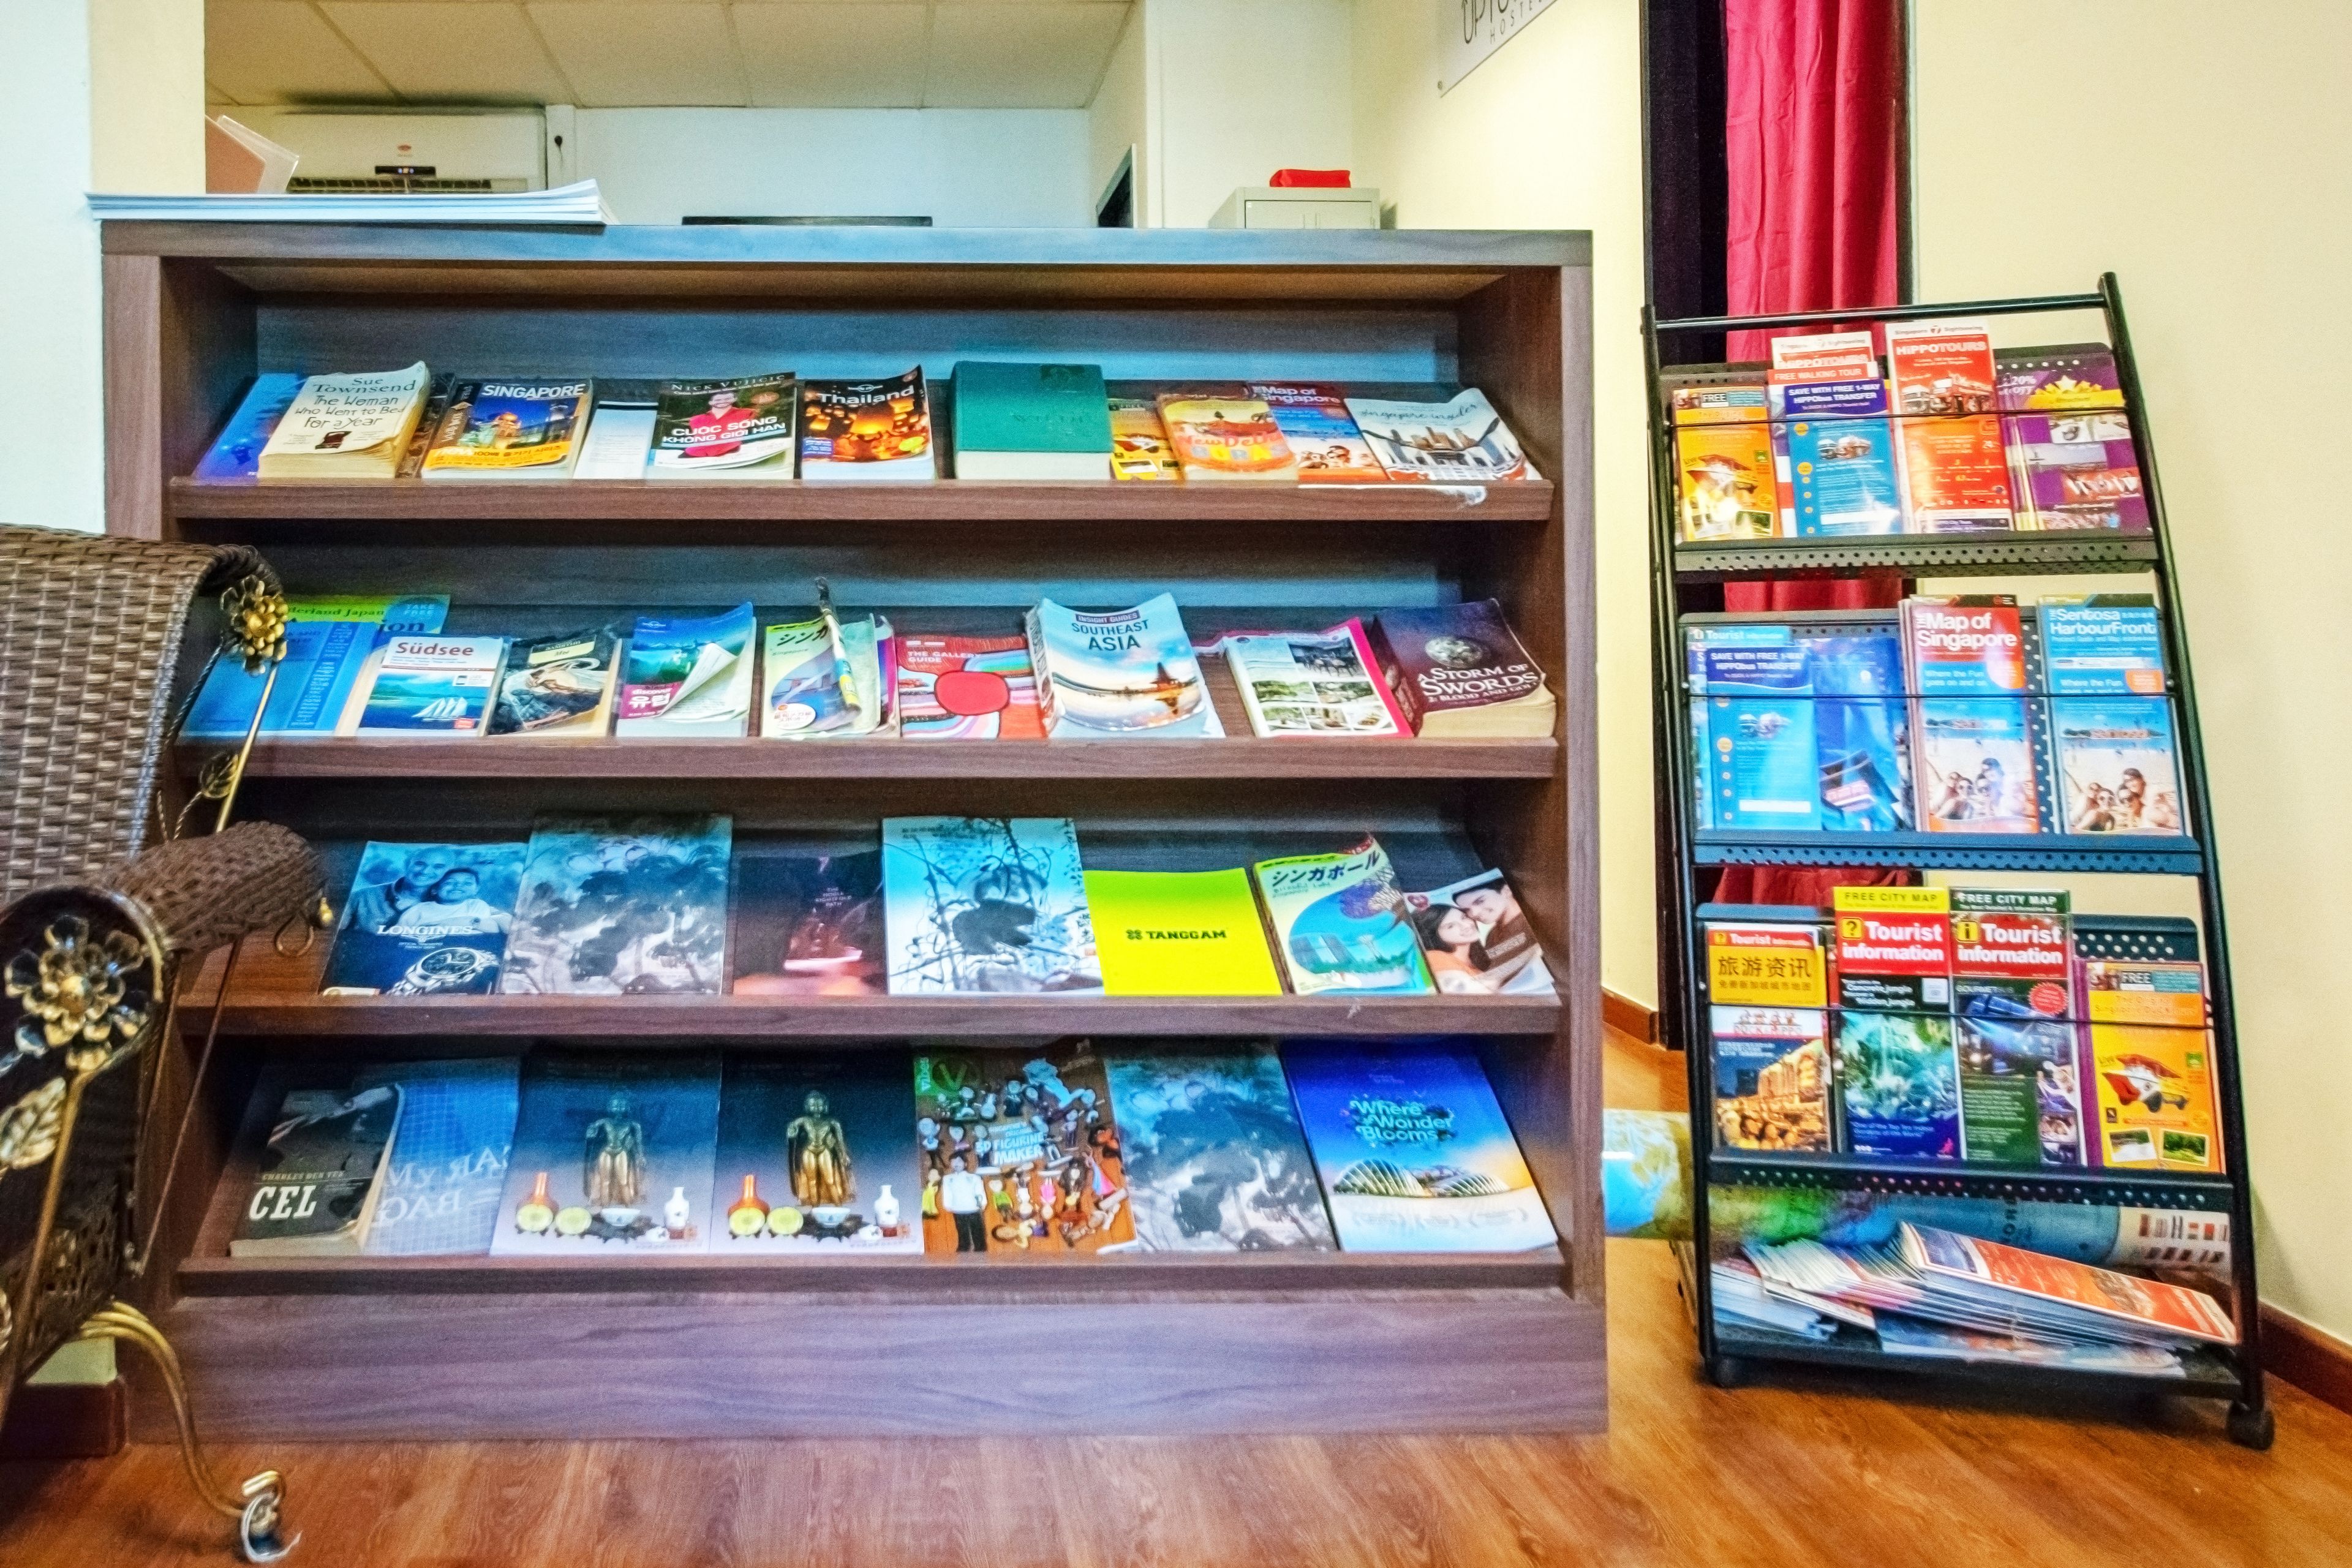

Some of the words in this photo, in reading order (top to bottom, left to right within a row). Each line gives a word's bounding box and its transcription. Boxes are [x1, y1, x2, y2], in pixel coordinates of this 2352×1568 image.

[352, 377, 384, 386] Sue
[1798, 370, 1837, 379] WALKING
[312, 379, 417, 393] Townsend
[481, 383, 587, 399] SINGAPORE
[1262, 385, 1298, 397] Map
[1300, 386, 1317, 395] of
[313, 395, 339, 405] The
[344, 396, 399, 406] Woman
[817, 385, 914, 404] Thailand
[1702, 393, 1727, 402] FREE
[379, 405, 407, 414] Bed
[304, 417, 331, 429] For
[333, 419, 343, 428] a
[337, 417, 383, 429] Year
[345, 607, 385, 617] Japan
[1077, 615, 1108, 624] INSIGHT
[1110, 612, 1138, 623] GUIDES
[2056, 608, 2121, 621] Sentosa
[1071, 619, 1149, 635] SOUTHEAST
[1926, 611, 1969, 631] Map
[1971, 611, 1992, 630] of
[2051, 621, 2157, 635] HarbourFront
[776, 625, 829, 647] シンガ
[1705, 630, 1745, 639] Tourist
[1917, 629, 2018, 651] Singapore
[394, 642, 475, 656] Südsee
[1088, 635, 1142, 651] ASIA
[1417, 673, 1431, 682] A
[1430, 666, 1504, 680] STORM
[1507, 663, 1529, 673] OF
[1420, 671, 1539, 696] SWORDS
[628, 693, 671, 709] 유럽
[1844, 892, 1876, 901] FREE
[1880, 892, 1907, 902] CITY
[1912, 894, 1938, 902] MAP
[1956, 892, 1993, 903] FREE
[1995, 894, 2026, 904] CITY
[2028, 895, 2058, 905] MAP
[376, 924, 474, 936] LONGINES
[1145, 929, 1227, 940] TANGGAM
[1864, 920, 1943, 941] Tourist
[1980, 922, 2064, 944] Tourist
[1729, 932, 1771, 945] Tourist
[1841, 941, 1945, 962] information
[1957, 944, 2064, 965] information
[1717, 956, 1812, 978] 旅游资讯
[2122, 972, 2152, 984] FREE
[1350, 1099, 1423, 1116] Where
[1363, 1114, 1453, 1129] Wonder
[1355, 1125, 1439, 1142] Blooms
[993, 1145, 1044, 1165] MAKER
[249, 1185, 318, 1221] CEL
